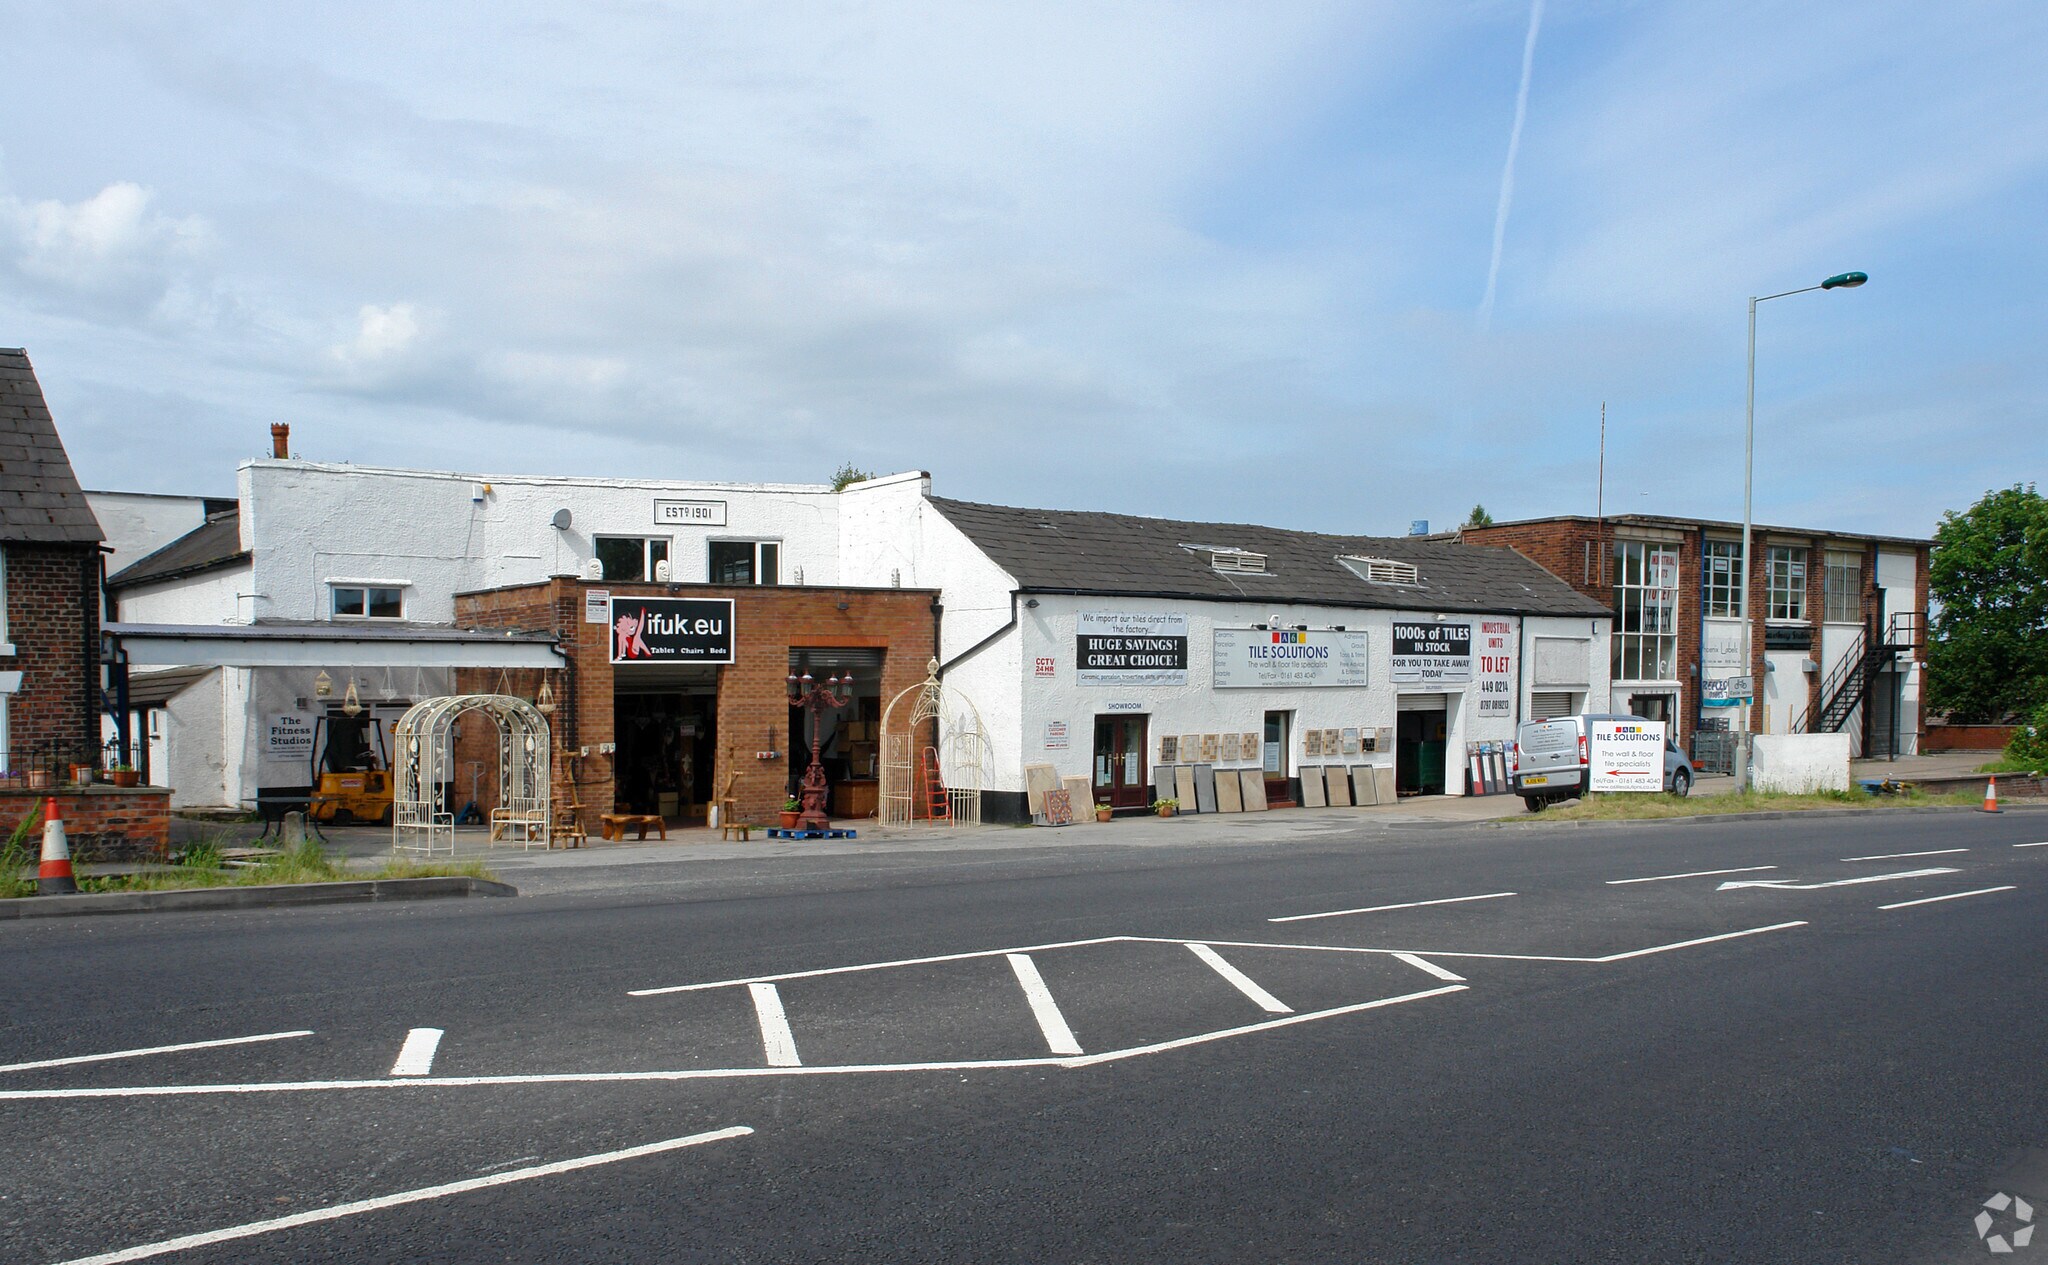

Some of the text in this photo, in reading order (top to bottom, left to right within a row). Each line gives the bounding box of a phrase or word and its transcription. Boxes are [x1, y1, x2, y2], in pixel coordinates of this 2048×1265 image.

[692, 507, 712, 519] 1901
[1082, 614, 1094, 622] We
[1096, 614, 1118, 624] import
[1132, 614, 1146, 623] tiles
[1147, 615, 1166, 623] direct
[1168, 615, 1183, 624] from
[647, 613, 723, 635] ifuk.eu
[1481, 621, 1511, 634] INDUSTRIAL
[1112, 625, 1124, 633] the
[1394, 626, 1470, 640] 1000s of TILES
[1088, 638, 1178, 651] HUGE SAVINGS!
[1414, 642, 1450, 652] IN STOCK
[1488, 637, 1503, 648] UNITS
[1248, 645, 1329, 659] TILE SOLUTIONS
[1035, 657, 1055, 666] CCTV
[1087, 654, 1178, 666] GREAT CHOICE!
[1248, 660, 1259, 668] The
[1259, 660, 1271, 668] wall
[1277, 660, 1290, 668] floor
[1300, 661, 1328, 669] specialists
[1392, 659, 1470, 668] FOR YOU TO TAKE AWAY
[1481, 656, 1510, 673] TO LET
[1421, 669, 1443, 678] TODAY
[1481, 681, 1508, 692] 449 0214
[1108, 702, 1142, 710] SHOWROOM
[1480, 700, 1491, 709] 0797
[280, 716, 301, 725] The
[271, 726, 311, 735] Fitness
[270, 736, 312, 745] Studios
[1596, 733, 1661, 741] TILE SOLUTIONS
[1616, 760, 1651, 768] specialists
